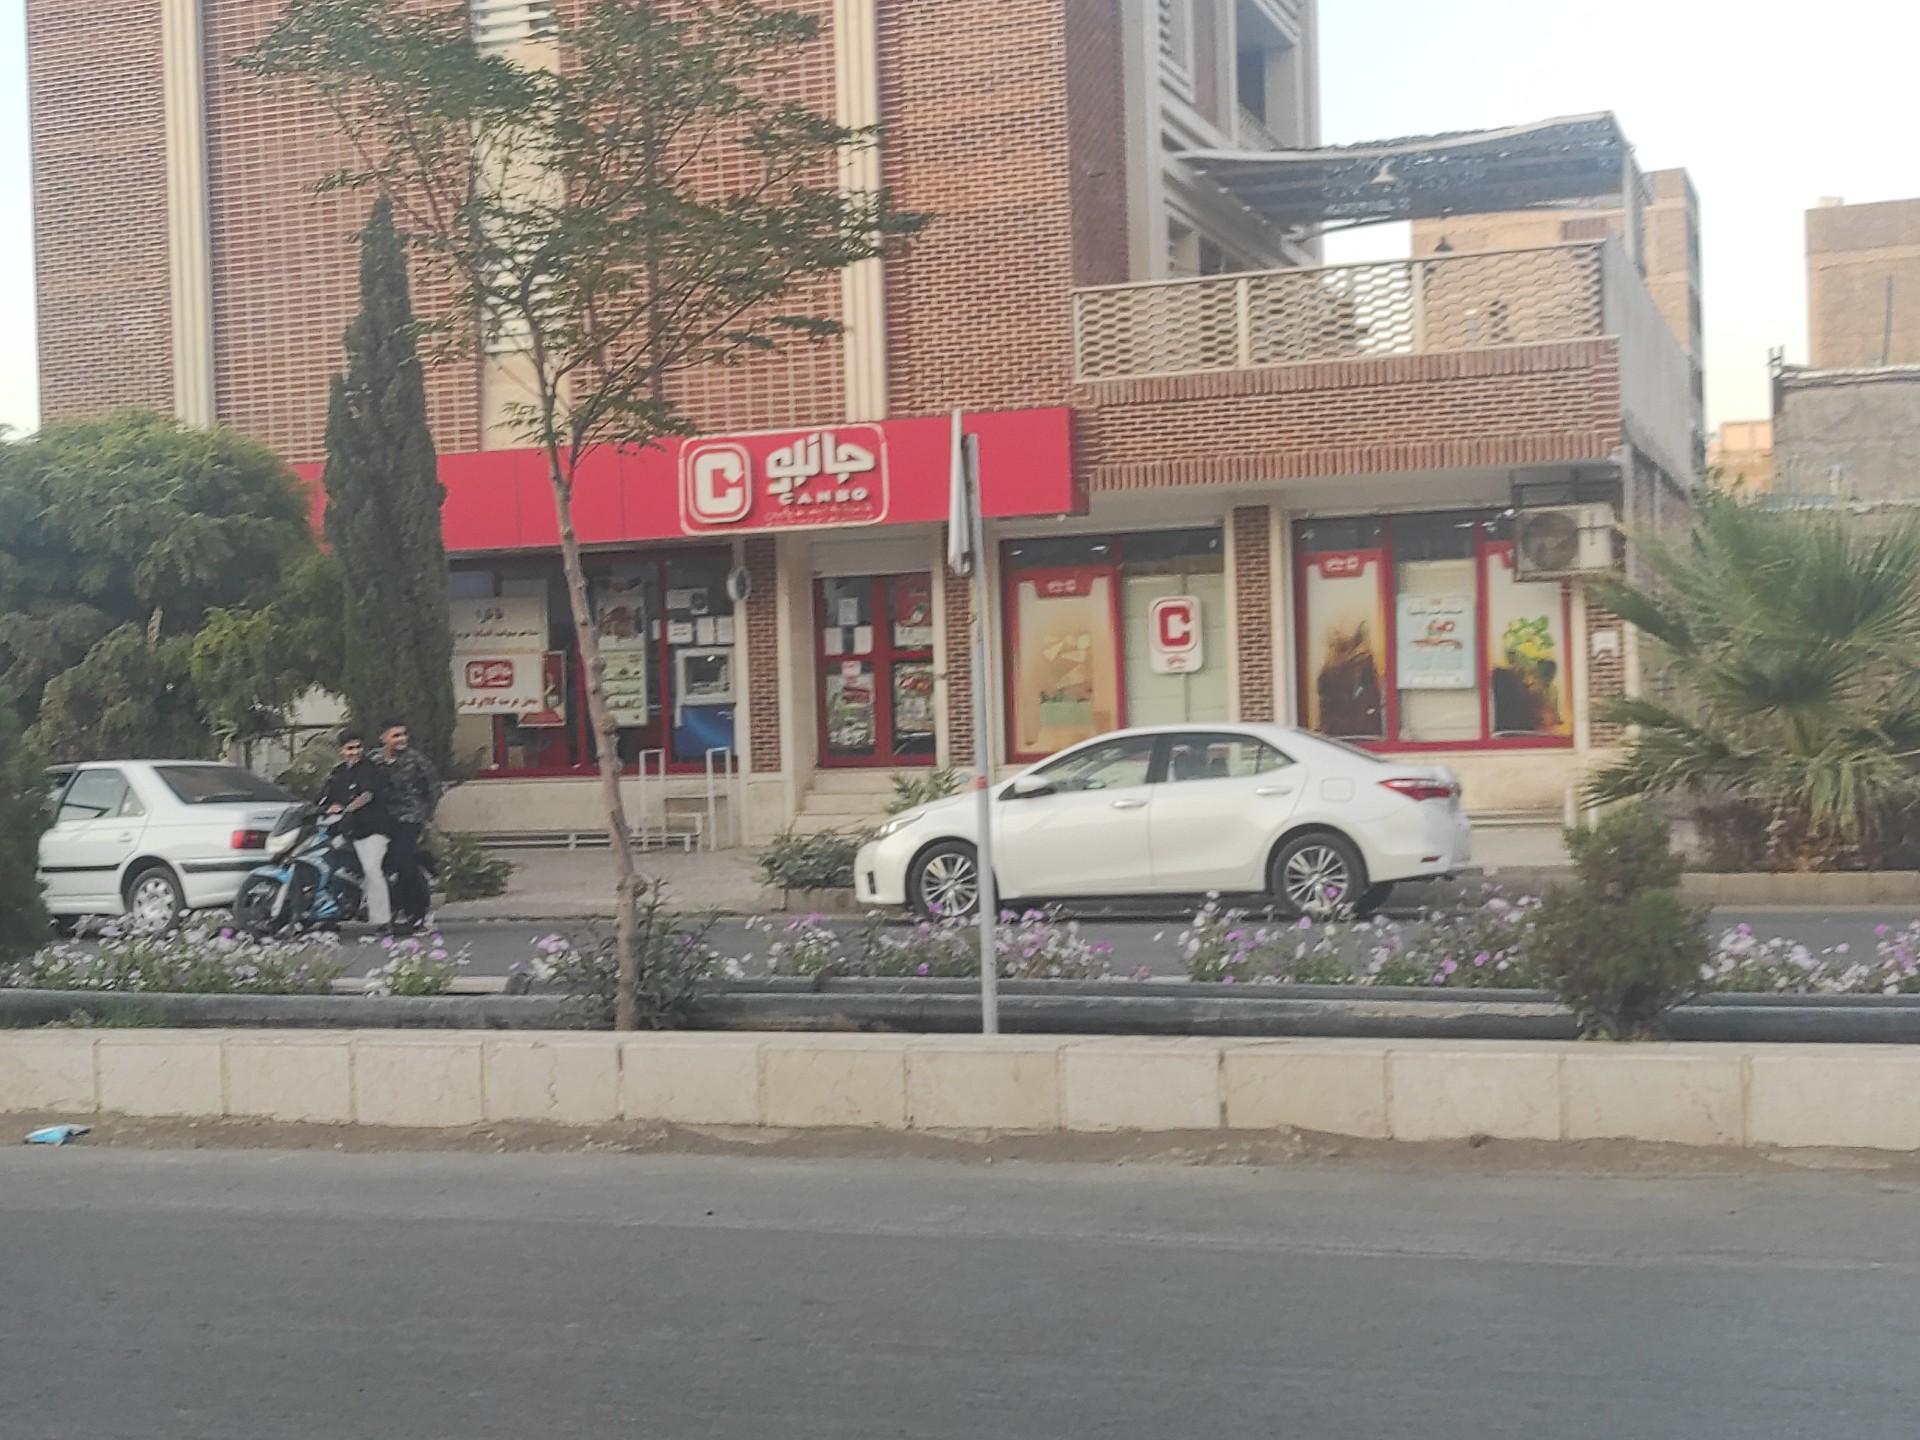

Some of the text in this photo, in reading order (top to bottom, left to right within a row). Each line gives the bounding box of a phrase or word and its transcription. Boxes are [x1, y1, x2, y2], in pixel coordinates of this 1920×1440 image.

[695, 451, 743, 514] C
[766, 432, 875, 495] جانبو
[1160, 606, 1191, 647] C
